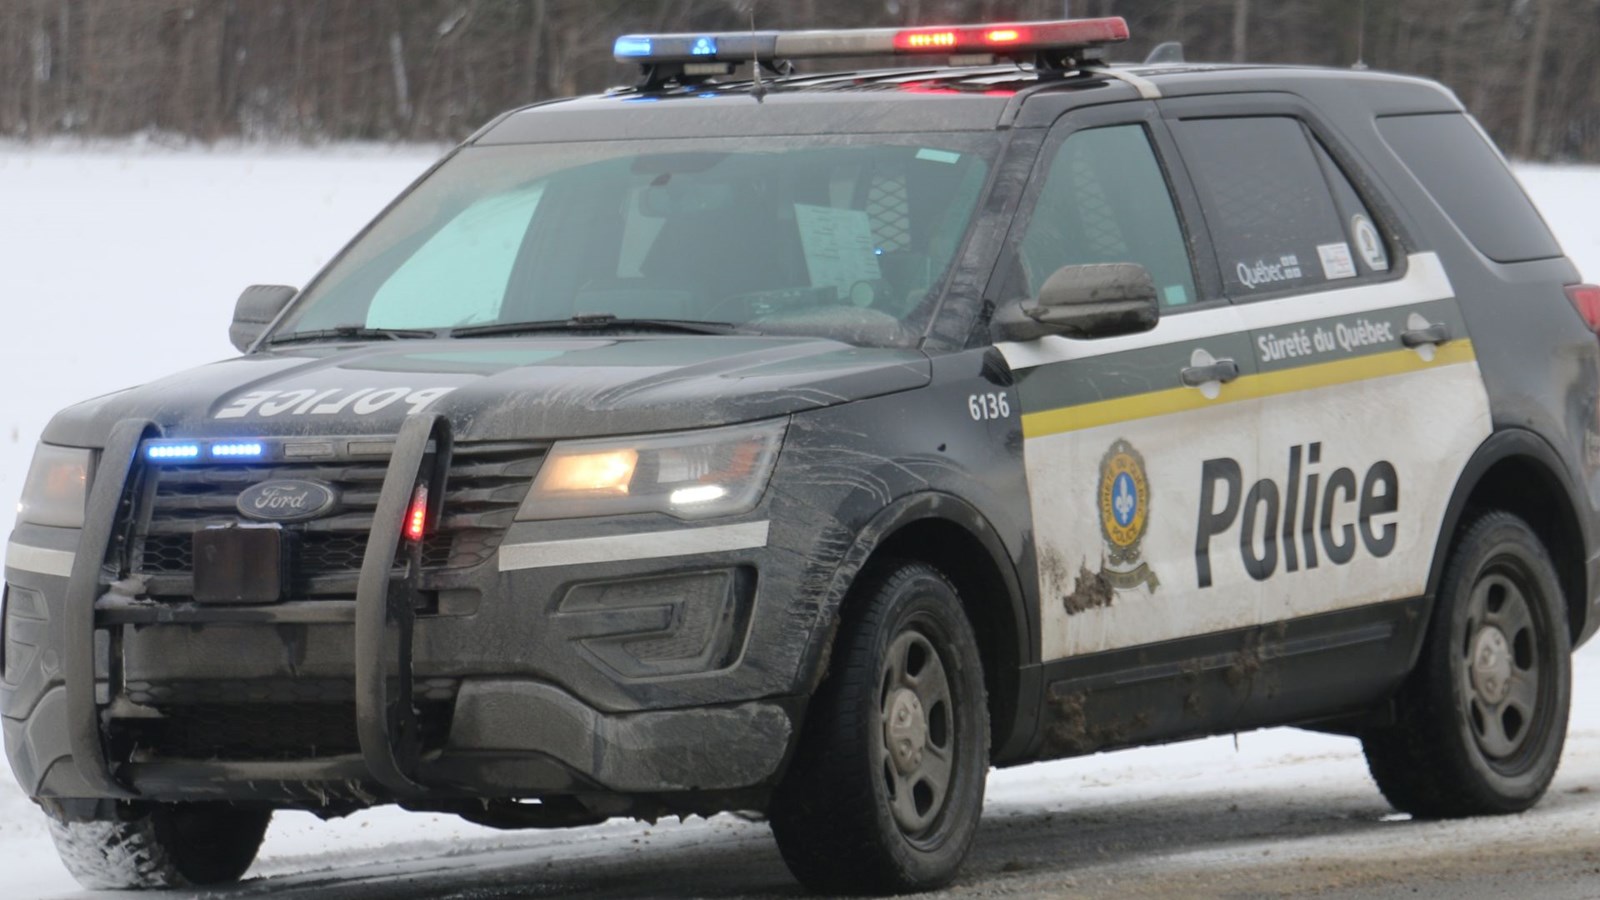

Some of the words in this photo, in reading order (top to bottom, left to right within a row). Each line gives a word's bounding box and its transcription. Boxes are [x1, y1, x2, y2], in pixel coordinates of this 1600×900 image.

[1236, 260, 1286, 289] Québec
[1257, 328, 1312, 362] Sûreté
[1314, 326, 1335, 352] du
[1335, 319, 1394, 351] Québec
[968, 391, 1010, 421] 6136
[254, 485, 308, 509] Ford
[1195, 441, 1399, 589] Police
